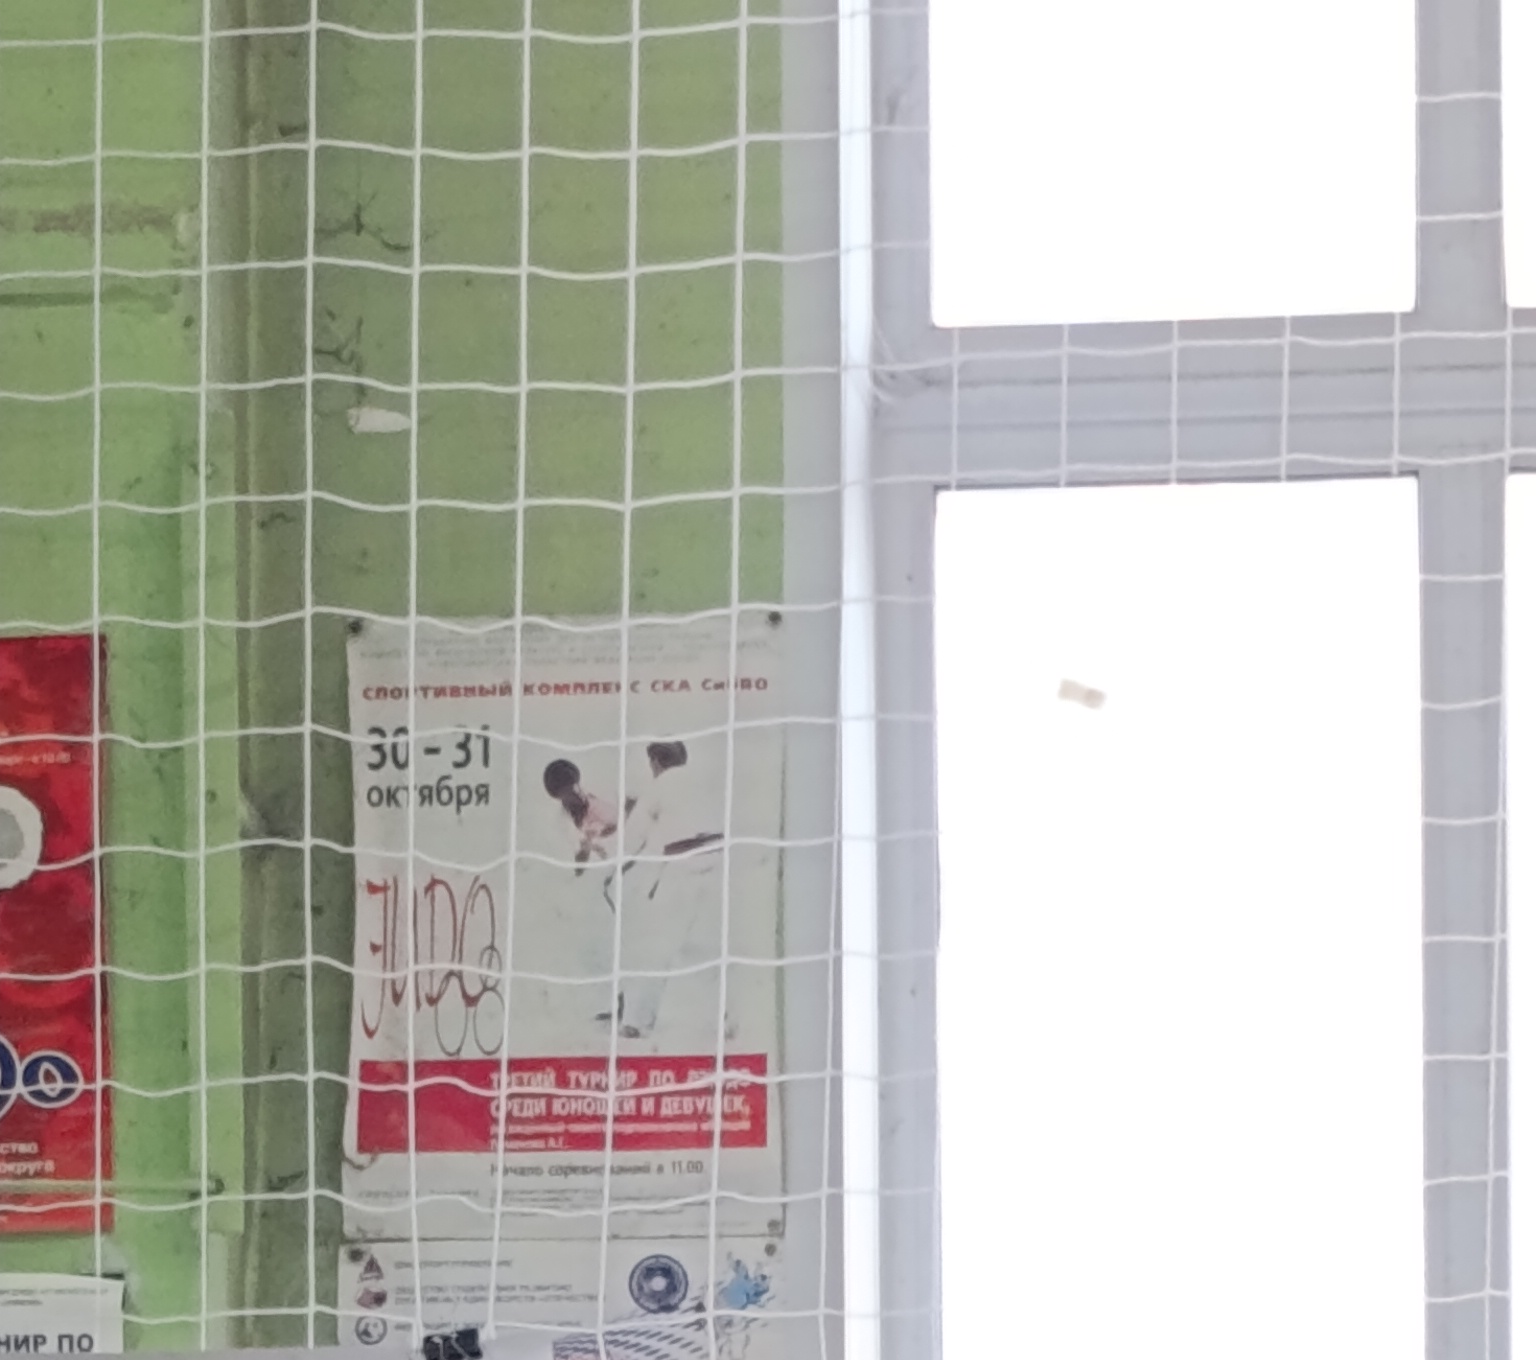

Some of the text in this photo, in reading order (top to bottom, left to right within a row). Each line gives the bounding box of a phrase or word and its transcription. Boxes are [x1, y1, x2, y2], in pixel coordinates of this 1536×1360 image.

[650, 678, 691, 693] СКА
[367, 726, 412, 770] 30
[451, 724, 490, 768] 31
[58, 1333, 94, 1353] ПО
